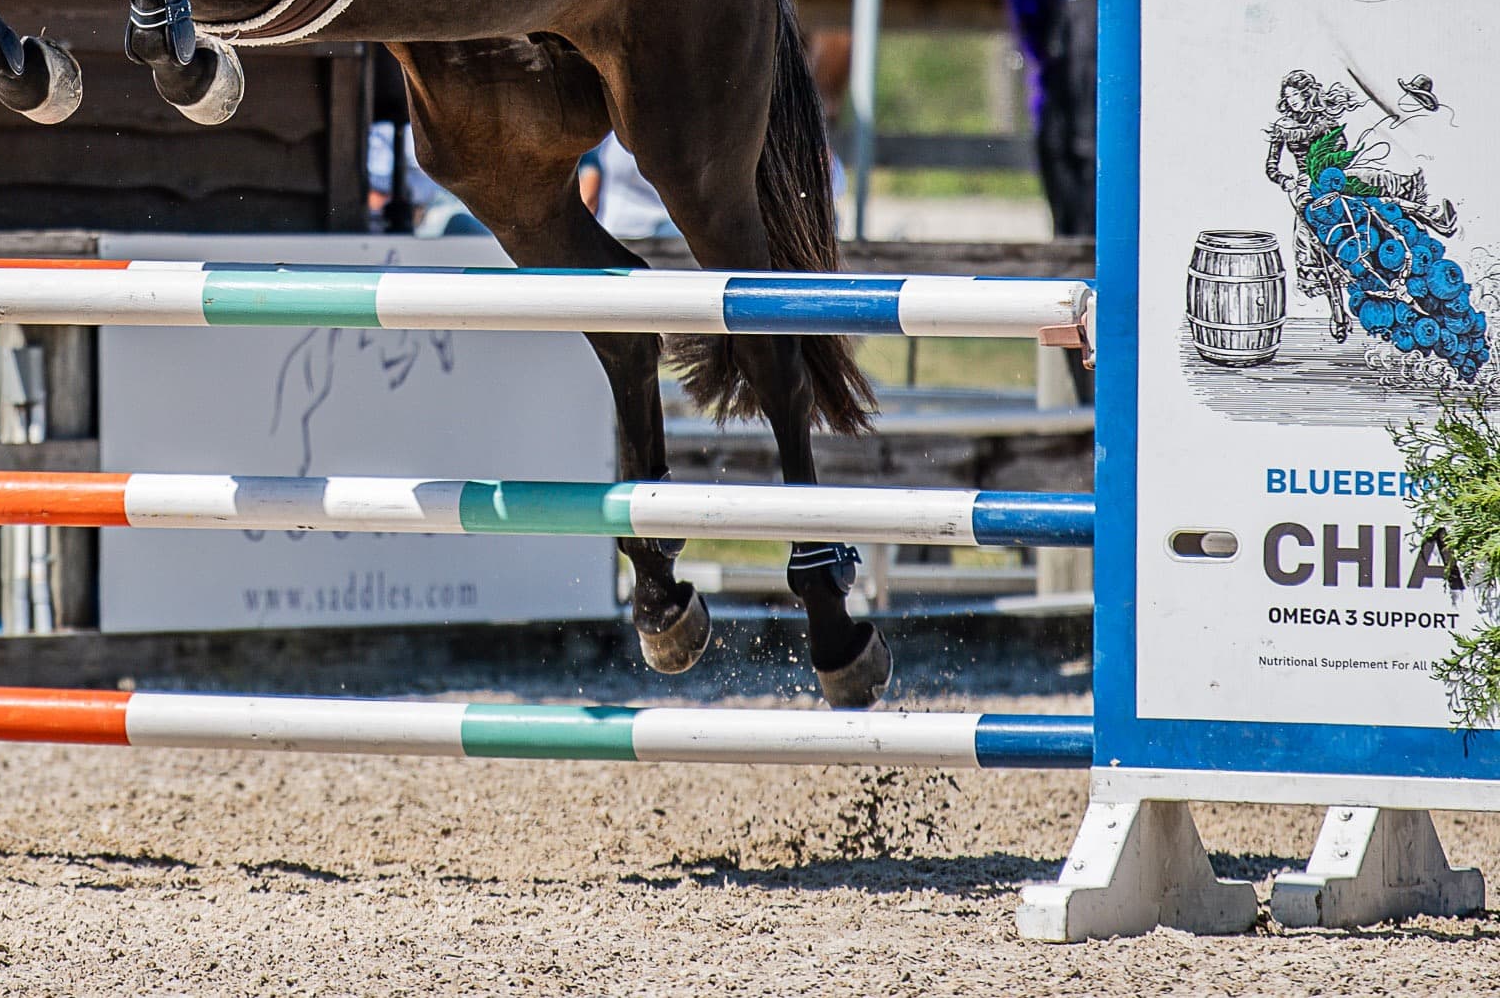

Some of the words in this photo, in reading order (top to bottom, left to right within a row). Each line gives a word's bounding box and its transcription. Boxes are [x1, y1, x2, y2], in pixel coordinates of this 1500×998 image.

[1263, 522, 1466, 590] CHIA
[1269, 607, 1341, 625] OMEGA
[1345, 609, 1358, 626] 3
[1362, 611, 1460, 629] SUPPORT
[1258, 656, 1318, 667] Nutritional
[1321, 658, 1388, 671] Supplement
[1392, 660, 1410, 670] For
[1412, 660, 1427, 671] All
